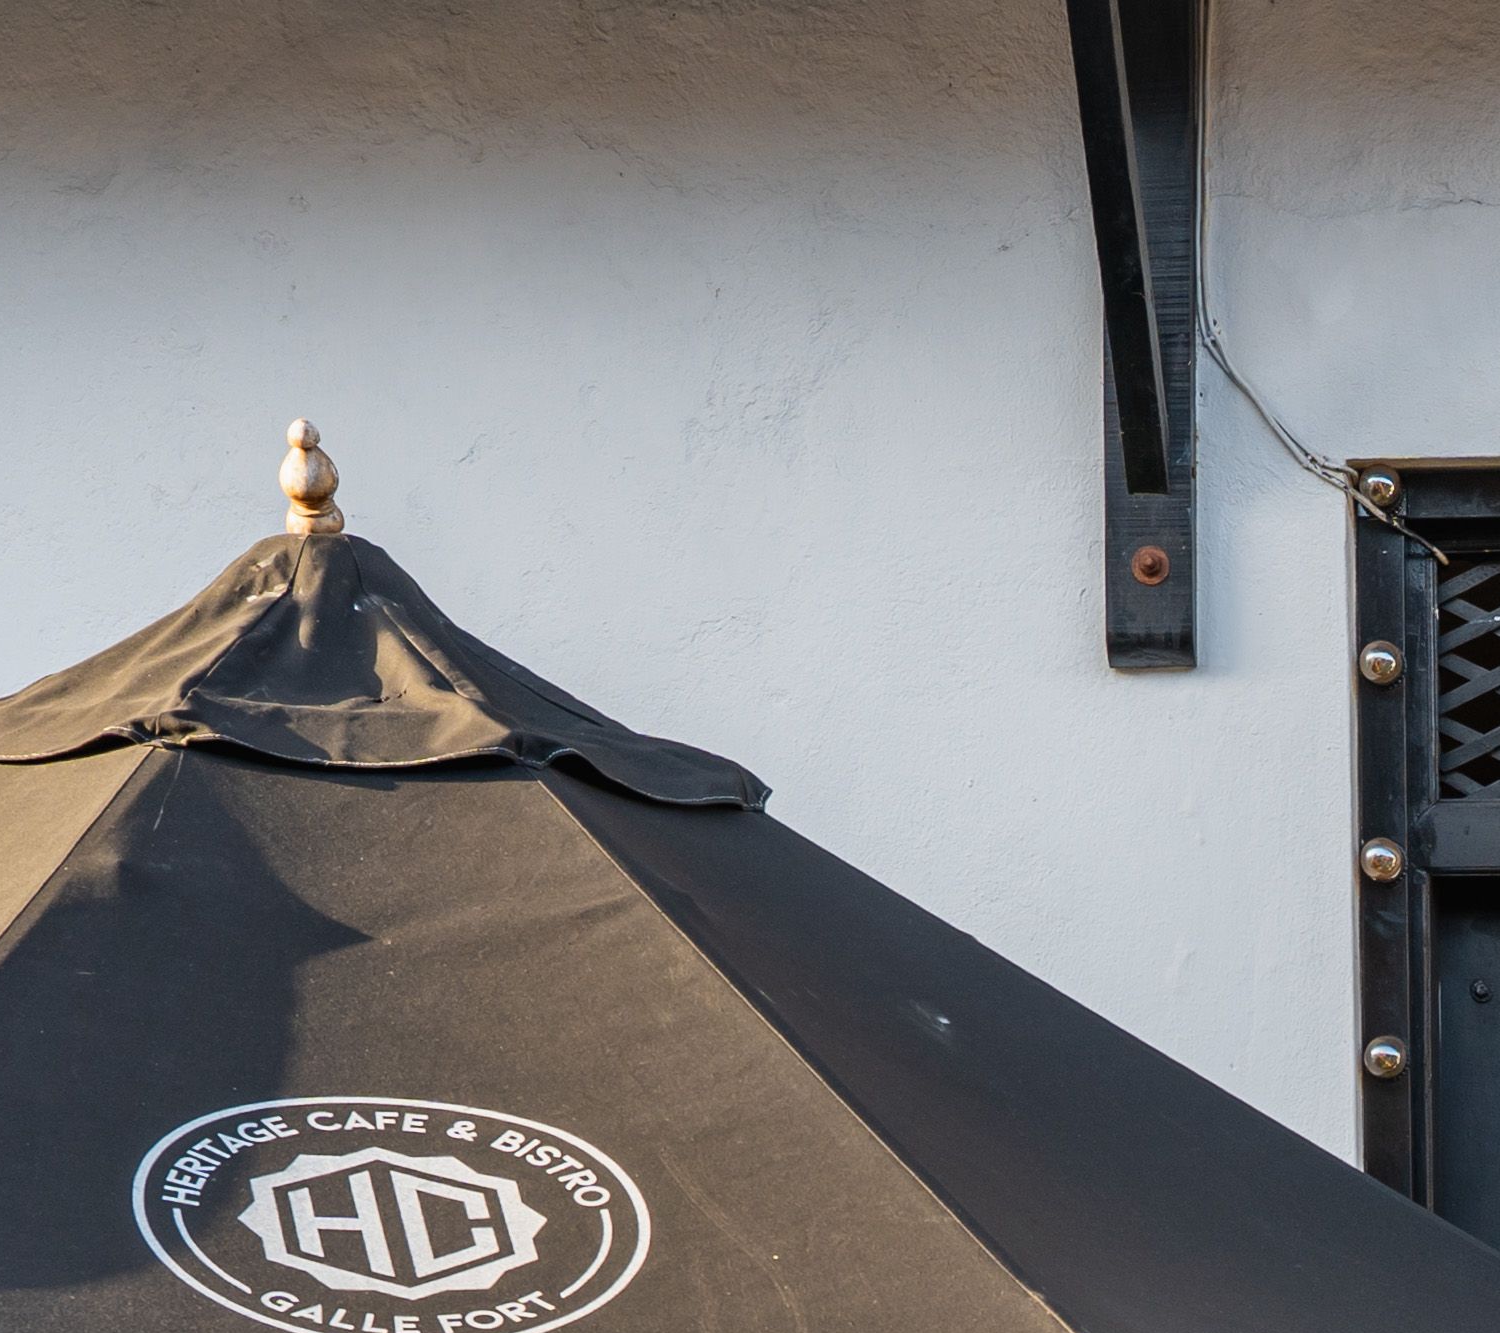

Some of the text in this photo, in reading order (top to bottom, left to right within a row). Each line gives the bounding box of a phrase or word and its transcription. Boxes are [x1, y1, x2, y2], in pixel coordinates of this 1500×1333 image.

[161, 1110, 612, 1208] HERITAGE CAFE & BISTRO
